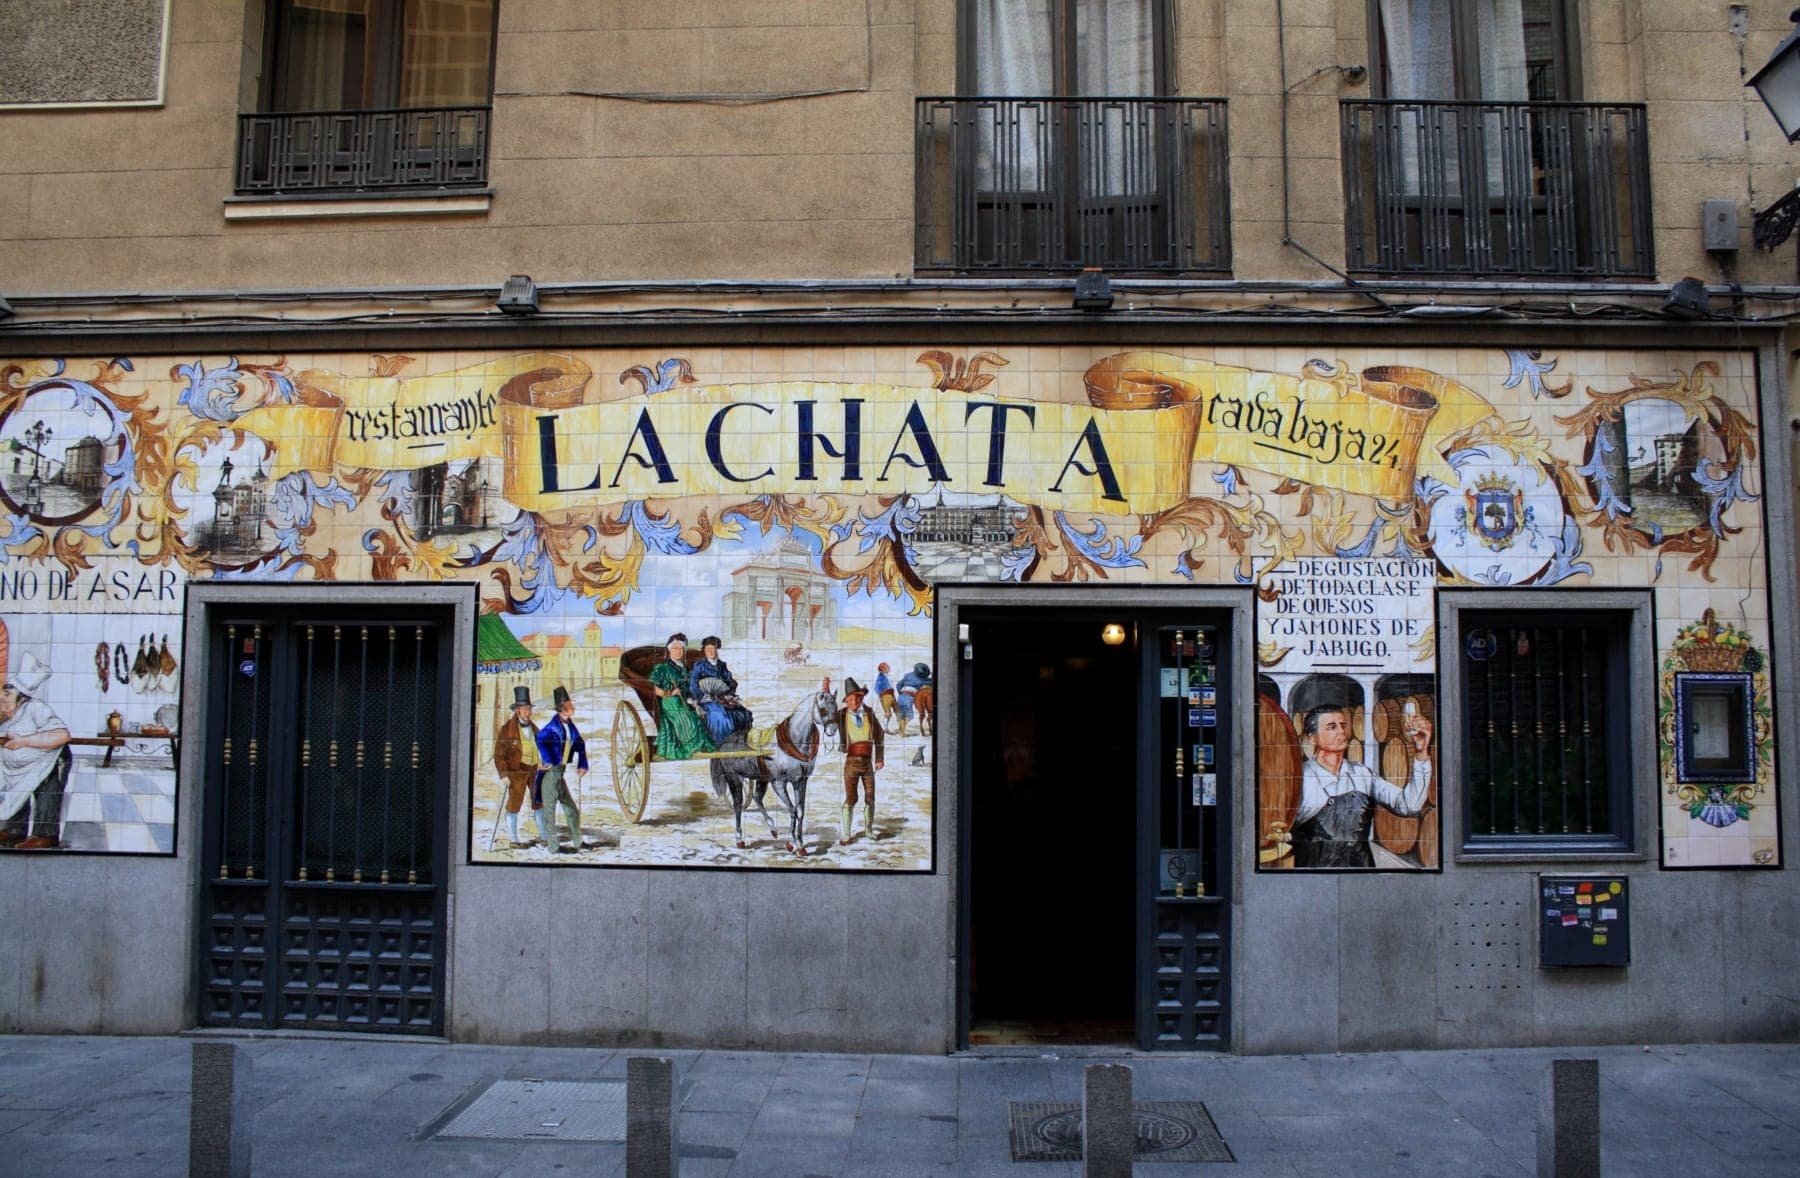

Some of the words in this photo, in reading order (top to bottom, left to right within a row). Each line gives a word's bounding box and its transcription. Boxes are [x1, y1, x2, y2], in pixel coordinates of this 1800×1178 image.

[345, 387, 497, 442] restaurante
[1298, 560, 1434, 577] DEGUSTACIÓN
[49, 570, 78, 601] DE
[87, 570, 176, 601] ASAR
[1276, 599, 1300, 614] DE
[1302, 599, 1374, 615] QUESOS
[1391, 620, 1418, 636] DE
[1302, 641, 1391, 657] JABUGO.
